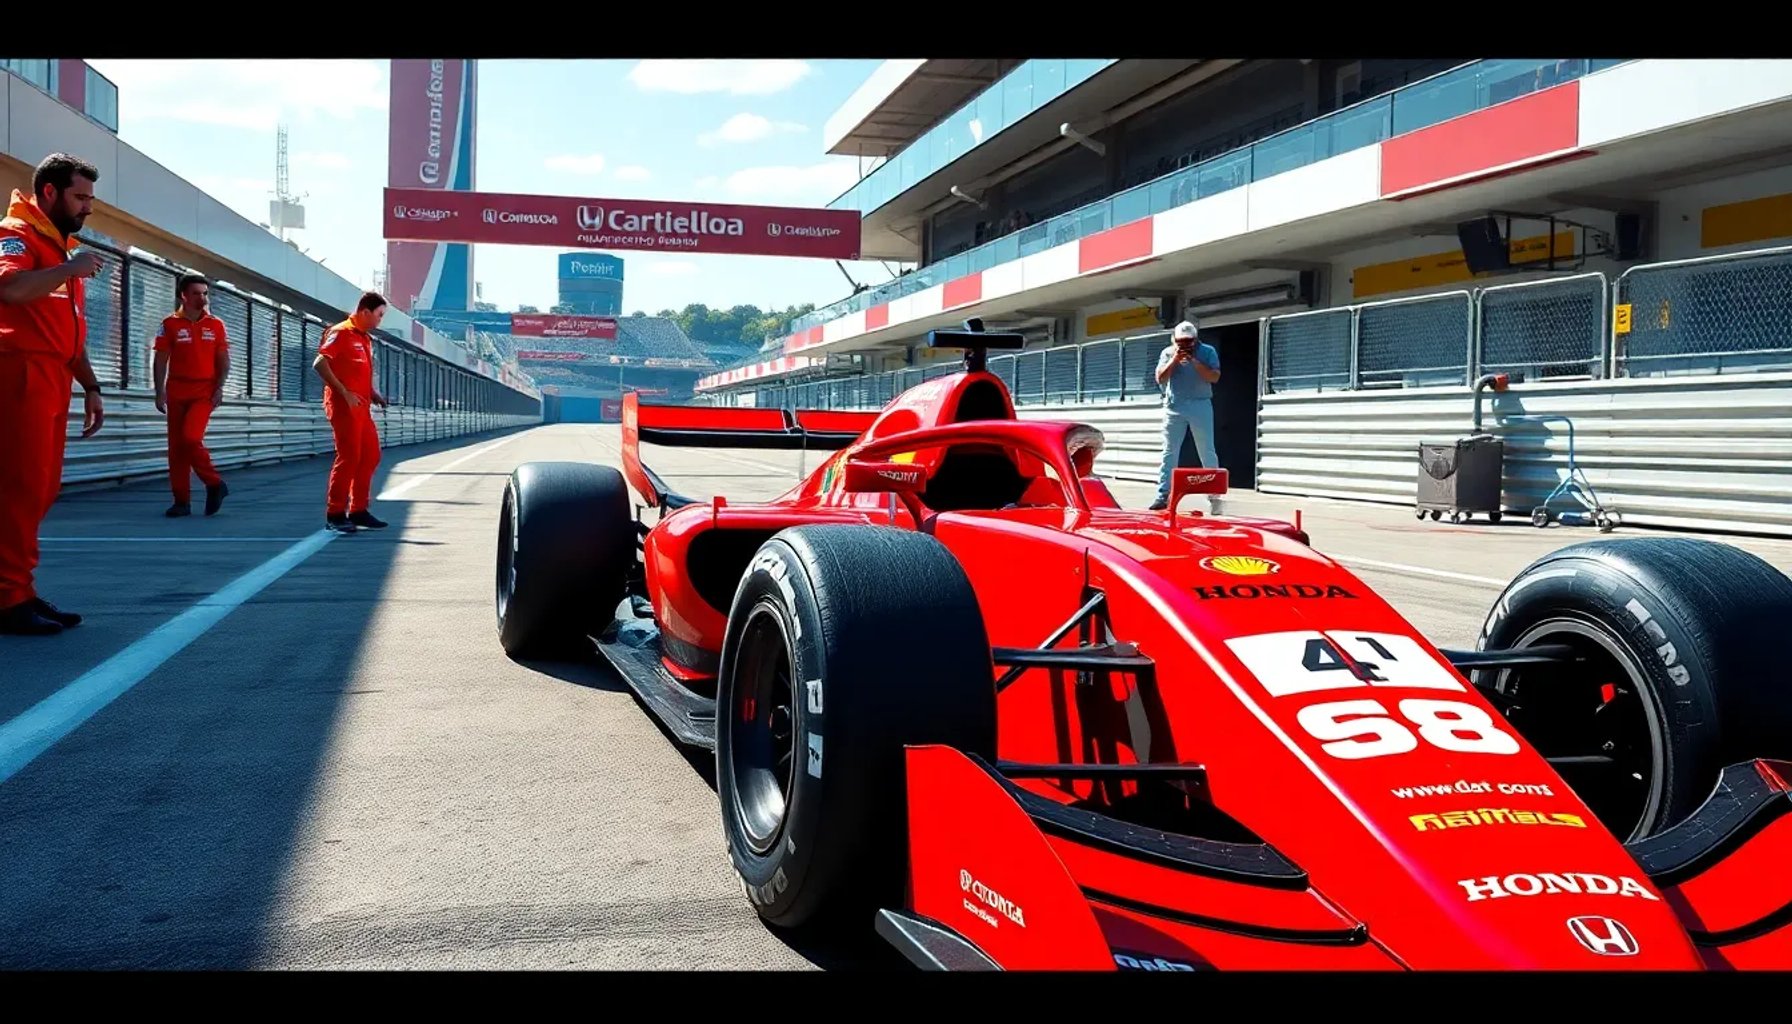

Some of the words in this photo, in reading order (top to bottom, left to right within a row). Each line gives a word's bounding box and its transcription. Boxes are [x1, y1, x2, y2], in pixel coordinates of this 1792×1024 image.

[608, 210, 744, 236] Cartielloa
[1194, 585, 1360, 600] HONDA
[1458, 873, 1660, 901] HONDA
